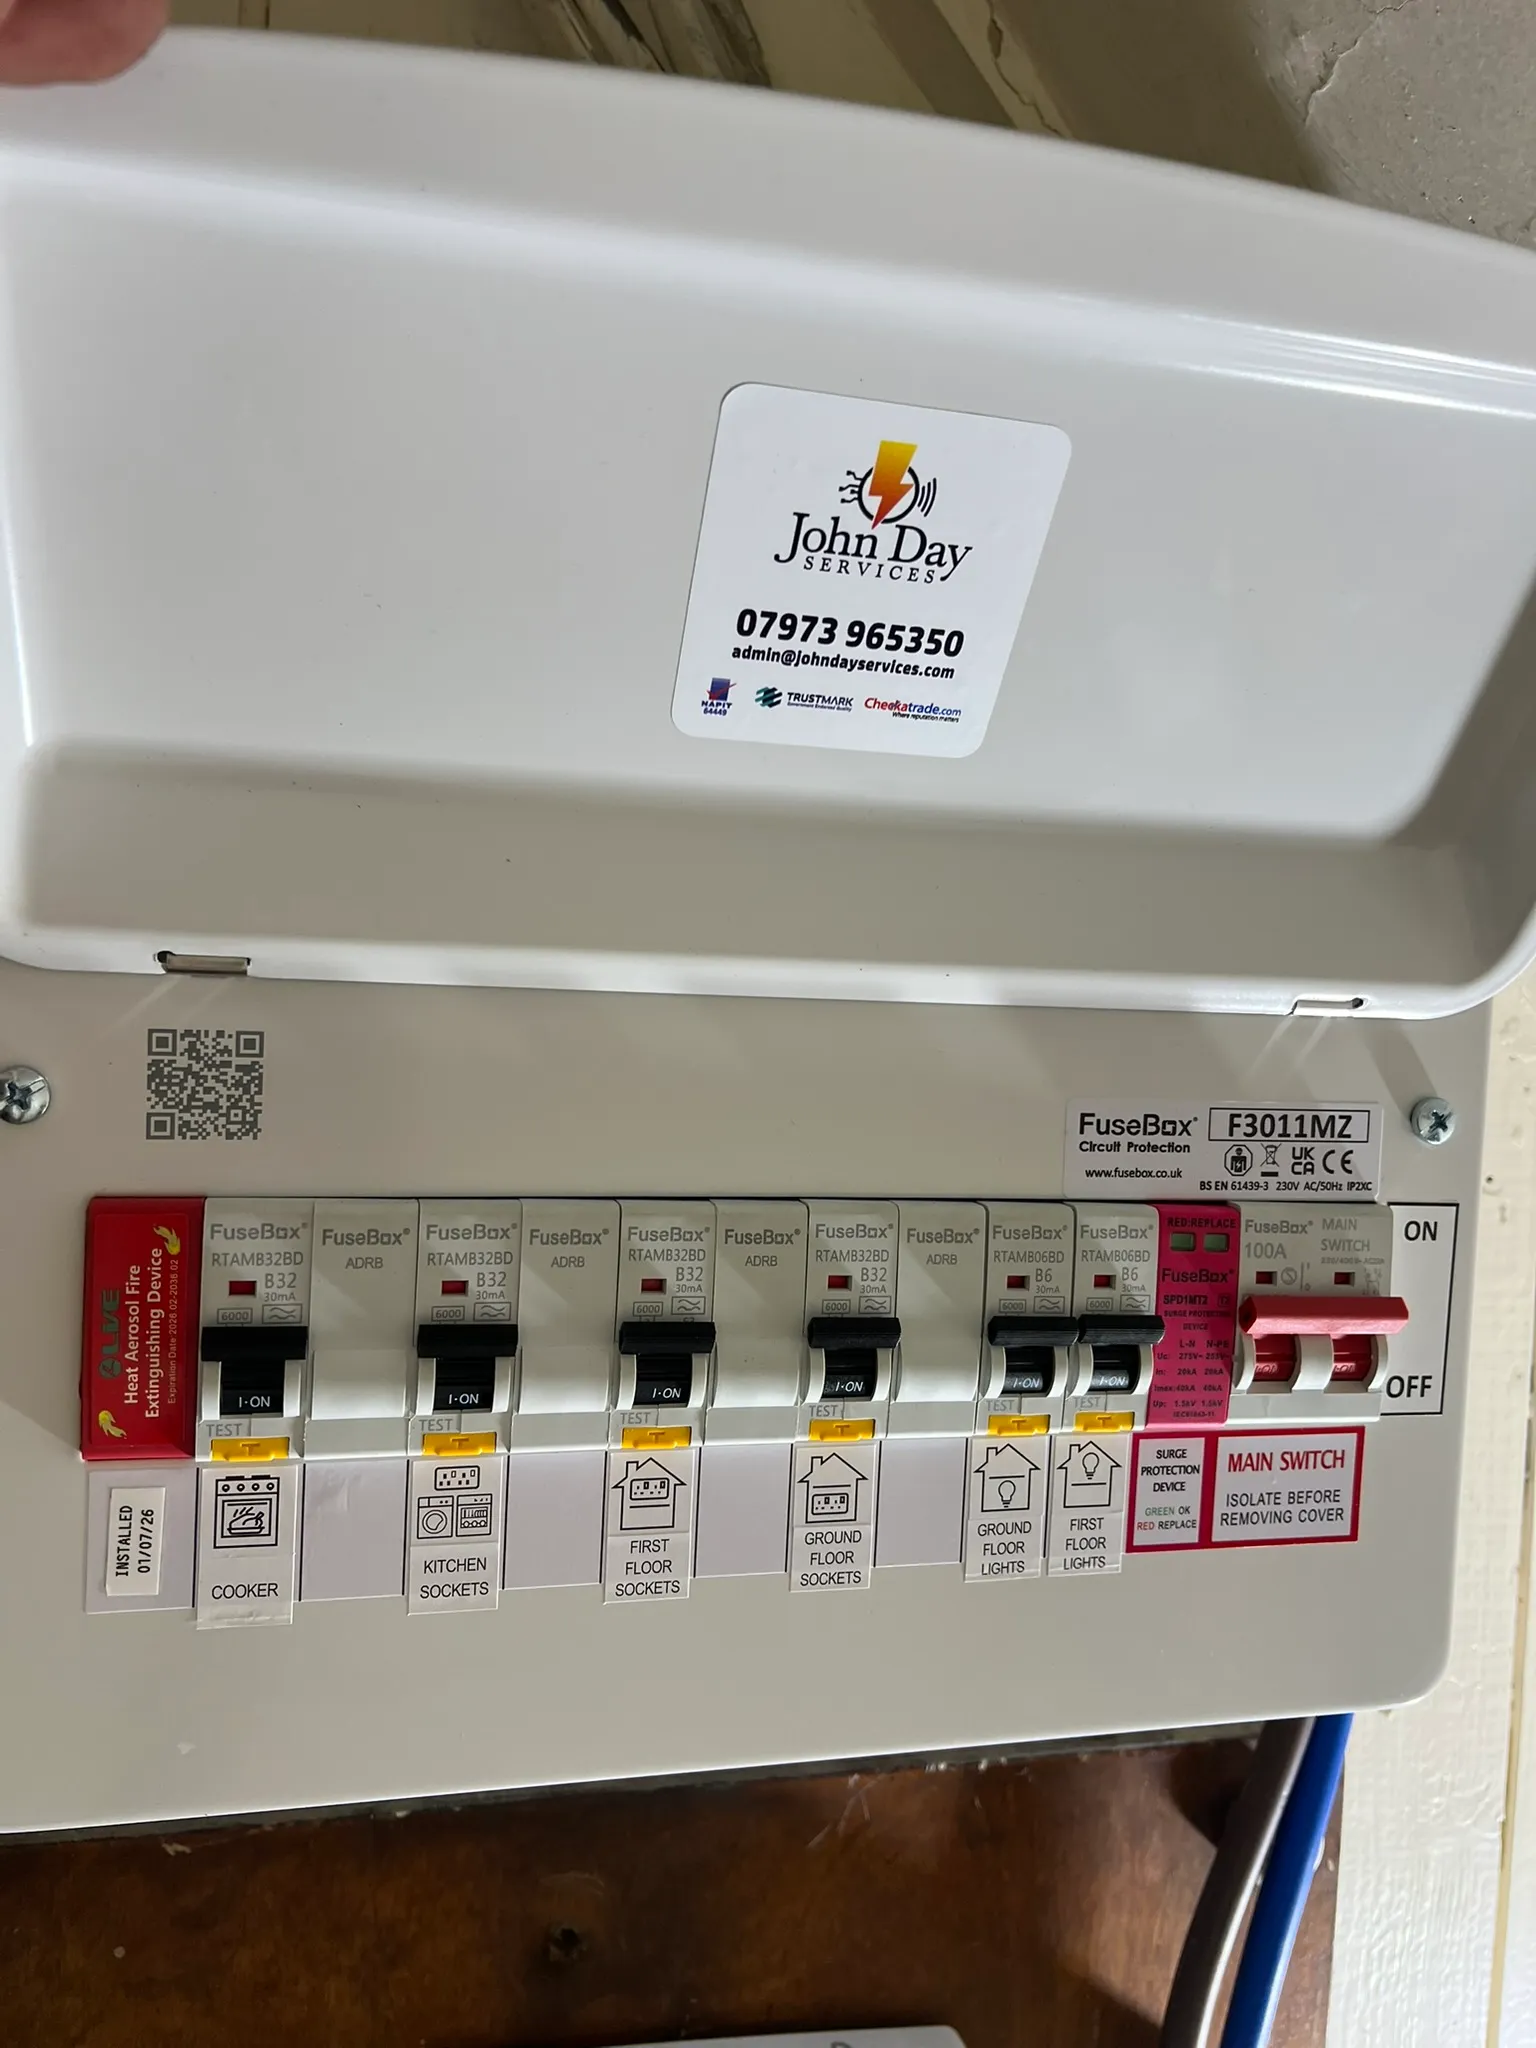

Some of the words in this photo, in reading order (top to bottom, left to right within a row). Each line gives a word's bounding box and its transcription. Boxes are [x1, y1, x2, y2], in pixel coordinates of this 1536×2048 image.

[774, 512, 878, 563] John
[888, 525, 972, 582] Day
[803, 556, 935, 584] SERVICES
[736, 608, 838, 645] 07973
[846, 620, 964, 657] 965350
[731, 645, 955, 680] admin@johndayservices.com
[701, 700, 733, 710] NAPIT
[787, 692, 854, 707] TRUSTMARK
[864, 697, 962, 717] Checkatrade.com
[1228, 1113, 1352, 1139] F3011MZ
[1079, 1141, 1121, 1153] Circuit
[1127, 1142, 1190, 1153] Protection
[1292, 1147, 1314, 1160] UK
[1085, 1167, 1182, 1179] www.fusebox.co.uk
[1291, 1161, 1315, 1175] CA
[1199, 1181, 1212, 1191] BS
[1214, 1181, 1228, 1191] EN
[1231, 1181, 1269, 1191] 61439-3
[1276, 1181, 1300, 1191] 230V
[1304, 1181, 1343, 1192] AC/50Hz
[1346, 1181, 1372, 1191] IP2XC
[1322, 1218, 1357, 1231] MAIN
[1404, 1220, 1438, 1242] ON
[1245, 1242, 1287, 1259] 100A
[1321, 1239, 1370, 1252] SWITCH
[212, 1251, 304, 1266] RTAMB32BD
[427, 1251, 513, 1266] RTAMB32BD
[551, 1256, 585, 1268] ADRB
[628, 1249, 706, 1262] RTAMB32BD
[745, 1255, 778, 1266] ADRB
[816, 1249, 889, 1262] RTAMB32BD
[926, 1254, 958, 1265] ADRB
[993, 1251, 1064, 1264] RTAMB06BD
[1082, 1249, 1150, 1262] RTAMB06BD
[346, 1257, 383, 1269] ADRB
[126, 1265, 141, 1295] Fire
[147, 1248, 162, 1302] Device
[264, 1272, 297, 1289] B32
[477, 1272, 506, 1288] B32
[675, 1267, 703, 1282] B32
[861, 1267, 887, 1282] B32
[1035, 1268, 1052, 1282] B6
[1122, 1267, 1138, 1280] B6
[475, 1290, 506, 1300] 30mA
[675, 1284, 703, 1293] 30mA
[860, 1285, 886, 1294] 30mA
[1035, 1285, 1060, 1294] 30mA
[1122, 1284, 1146, 1293] 30mA
[264, 1292, 296, 1302] 30mA
[636, 1305, 660, 1314] 6000
[825, 1302, 847, 1311] 6000
[1002, 1301, 1024, 1310] 6000
[1090, 1300, 1111, 1309] 6000
[221, 1311, 249, 1321] 6000
[435, 1309, 461, 1319] 6000
[125, 1300, 140, 1362] Aerosol
[145, 1308, 164, 1418] Extinguishing
[124, 1367, 139, 1404] Heat
[168, 1361, 180, 1404] Expiration
[1386, 1375, 1432, 1399] OFF
[986, 1400, 1015, 1412] TEST
[1073, 1397, 1101, 1408] TEST
[620, 1412, 651, 1424] TEST
[809, 1405, 838, 1417] TEST
[206, 1423, 243, 1437] TEST
[419, 1419, 453, 1432] TEST
[1156, 1449, 1187, 1459] SURGE
[1228, 1452, 1273, 1472] MAIN
[1280, 1450, 1345, 1471] SWITCH
[1141, 1464, 1200, 1476] PROTECTION
[1153, 1482, 1185, 1492] DEVICE
[1226, 1491, 1282, 1507] ISOLATE
[1288, 1489, 1341, 1505] BEFORE
[1145, 1506, 1175, 1516] GREEN
[1178, 1506, 1190, 1515] OK
[1220, 1509, 1292, 1526] REMOVING
[1298, 1507, 1344, 1523] COVER
[977, 1521, 1031, 1537] GROUND
[1070, 1517, 1104, 1531] FIRST
[1137, 1521, 1155, 1531] RED
[1158, 1519, 1197, 1530] REPLACE
[115, 1505, 133, 1577] INSTALLED
[138, 1509, 154, 1573] 01/07/26
[804, 1531, 862, 1546] GROUND
[1065, 1537, 1106, 1551] FLOOR
[630, 1539, 670, 1554] FIRST
[983, 1542, 1025, 1556] FLOOR
[810, 1551, 854, 1566] FLOOR
[1063, 1556, 1106, 1570] LIGHTS
[424, 1558, 487, 1574] KITCHEN
[625, 1560, 672, 1576] FLOOR
[981, 1561, 1025, 1576] LIGHTS
[800, 1571, 862, 1587] SOCKETS
[212, 1583, 279, 1600] COOKER
[420, 1582, 489, 1600] SOCKETS
[615, 1580, 680, 1597] SOCKETS
